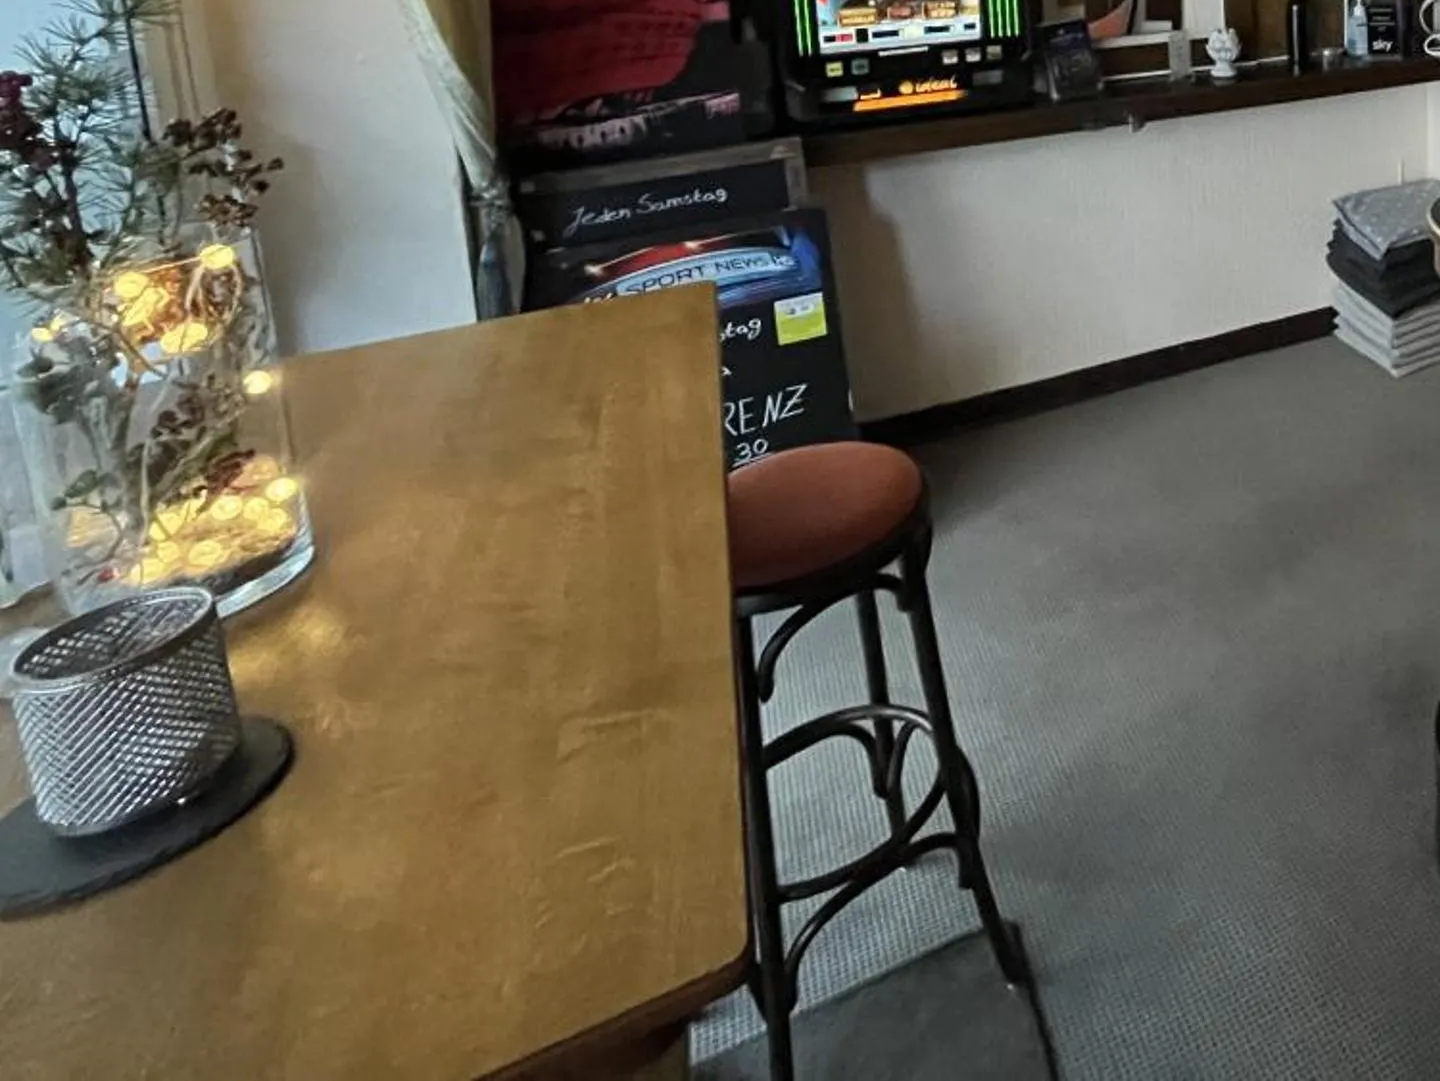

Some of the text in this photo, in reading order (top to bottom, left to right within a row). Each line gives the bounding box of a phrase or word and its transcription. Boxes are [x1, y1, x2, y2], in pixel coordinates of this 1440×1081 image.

[1372, 36, 1393, 52] sky
[565, 187, 728, 237] Jeden Samstag
[624, 265, 706, 293] SPORT
[715, 256, 769, 272] NEWS
[719, 318, 762, 343] tag
[724, 384, 808, 437] RENZ
